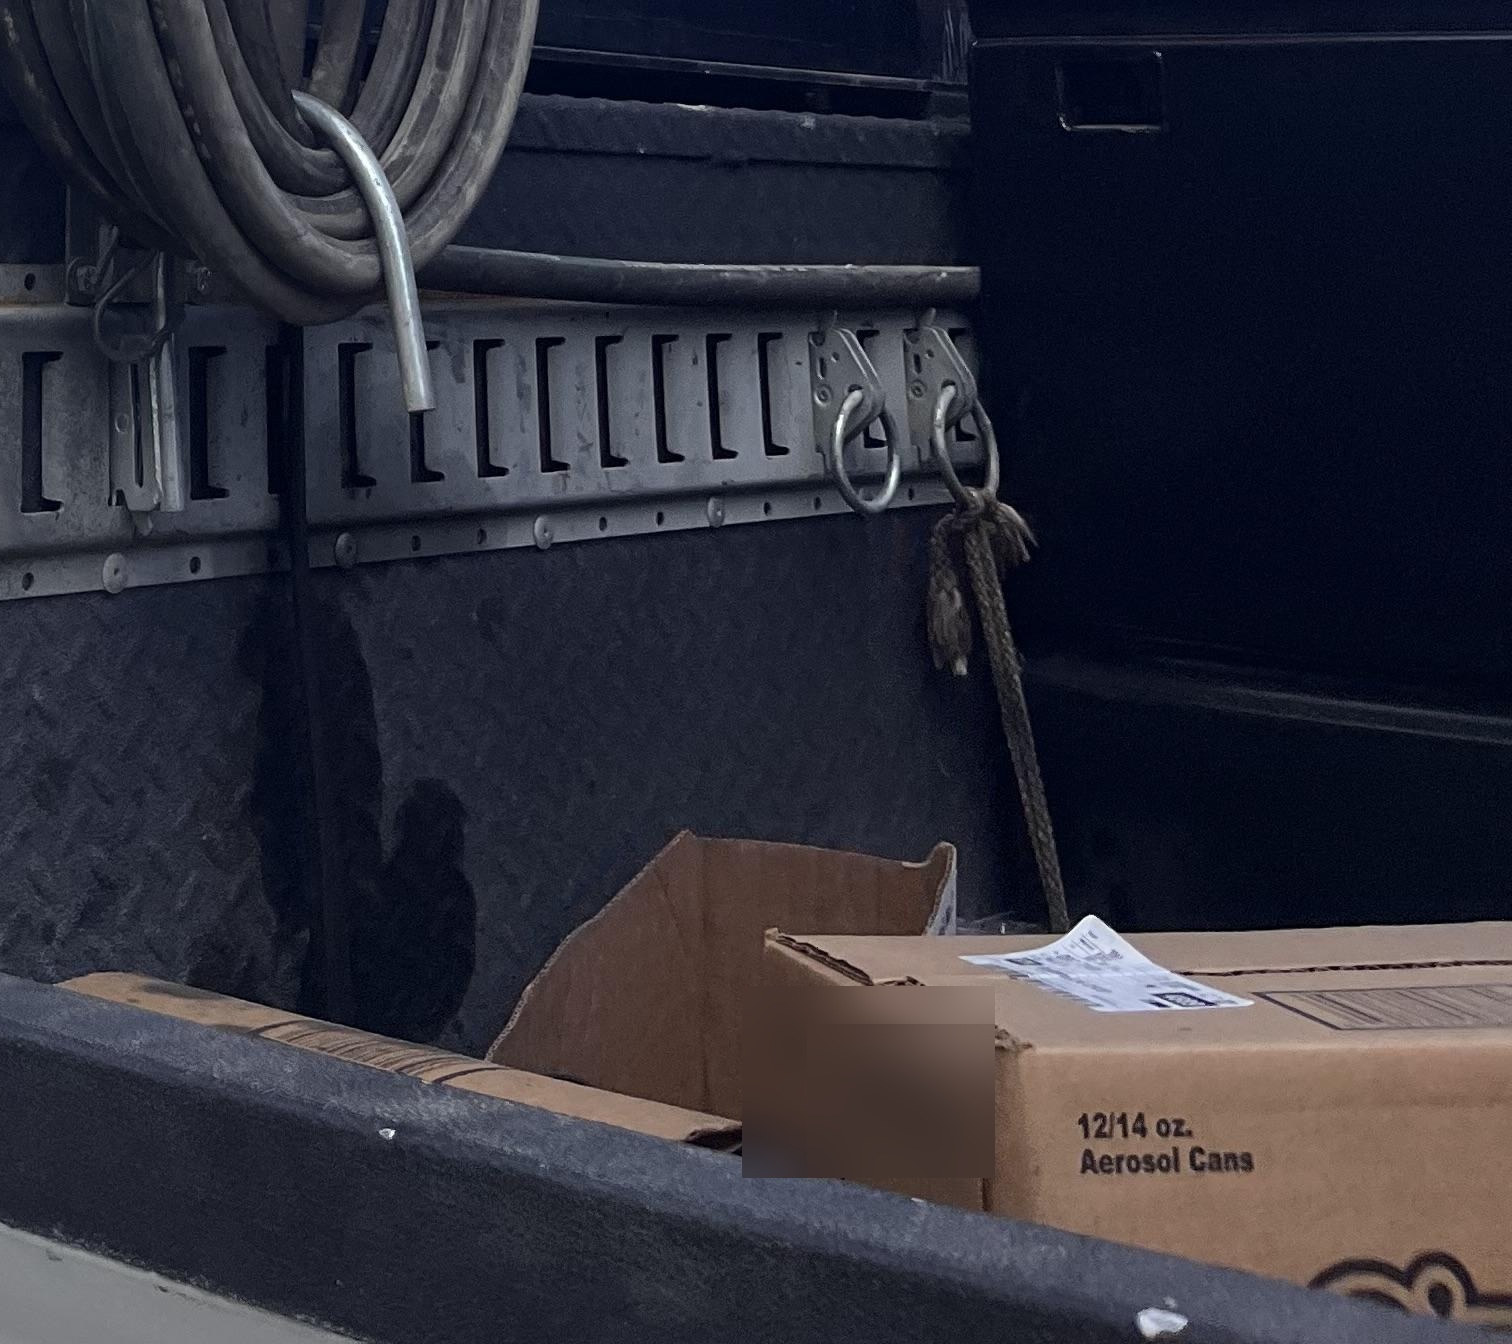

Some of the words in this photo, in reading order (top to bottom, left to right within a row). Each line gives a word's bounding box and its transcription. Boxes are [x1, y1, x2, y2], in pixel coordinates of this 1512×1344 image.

[1078, 1112, 1148, 1139] 12/14
[1156, 1118, 1193, 1138] oz.
[1080, 1146, 1181, 1175] Aerosol
[1189, 1146, 1254, 1174] Cans
